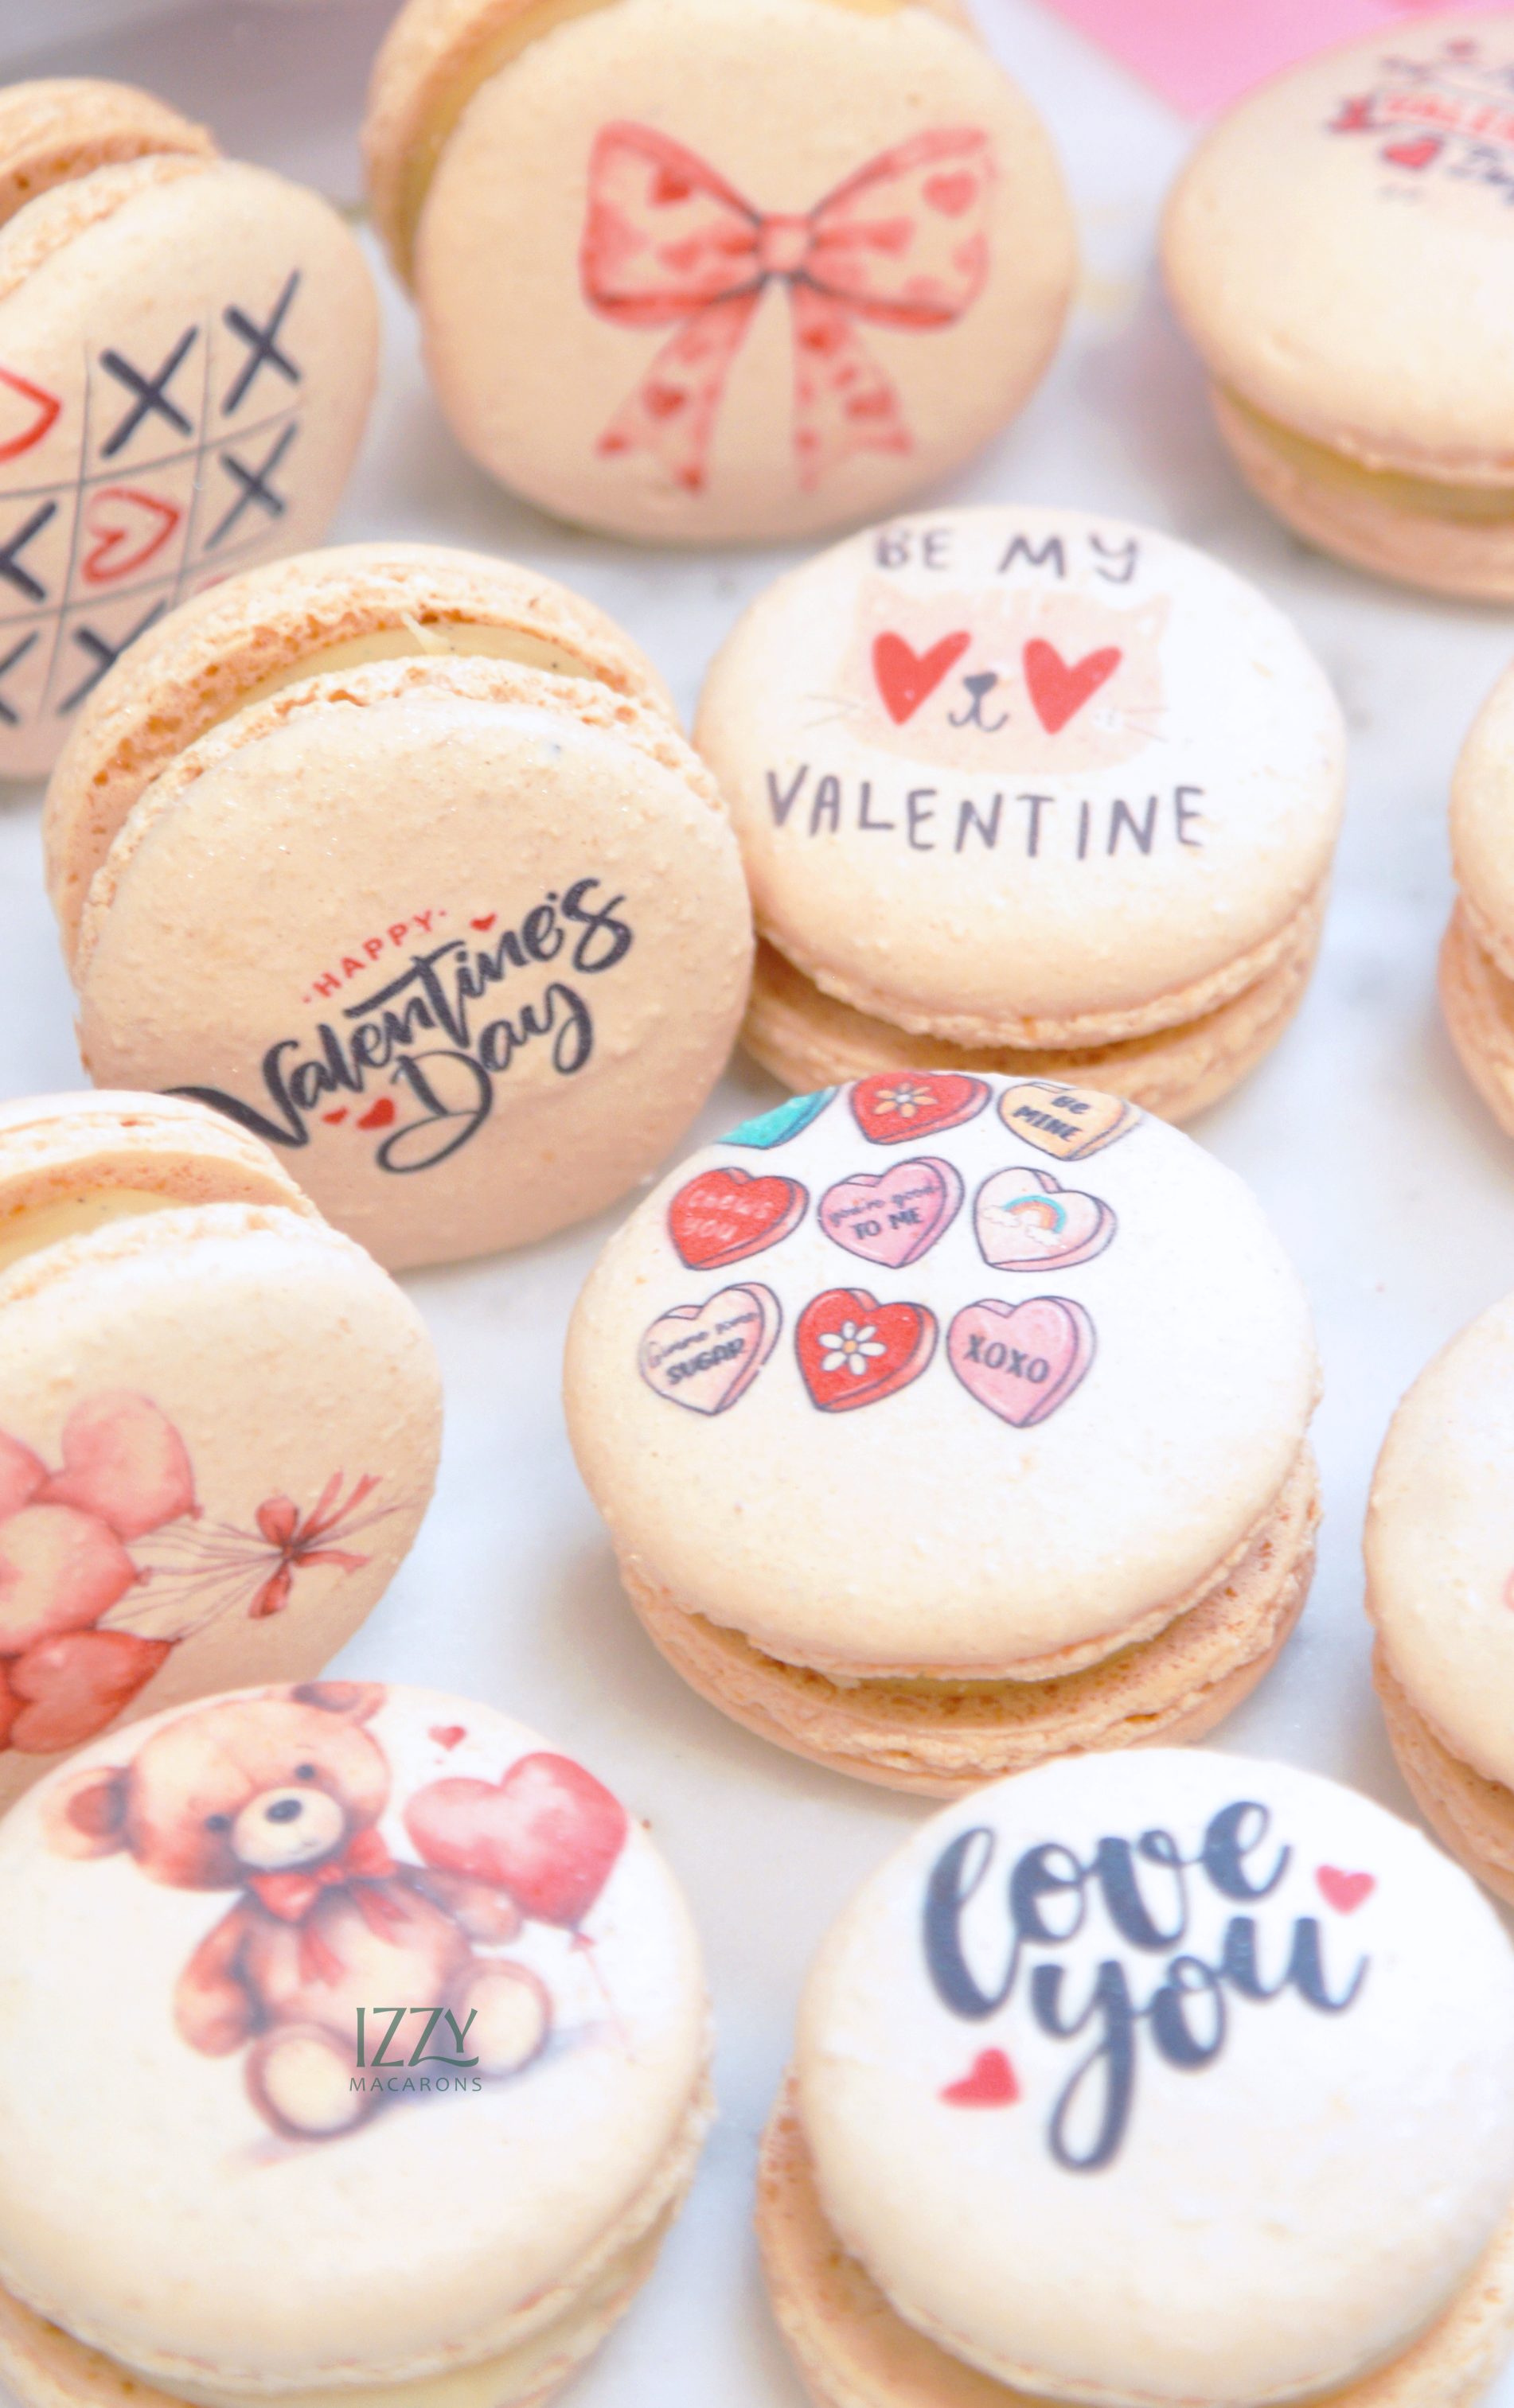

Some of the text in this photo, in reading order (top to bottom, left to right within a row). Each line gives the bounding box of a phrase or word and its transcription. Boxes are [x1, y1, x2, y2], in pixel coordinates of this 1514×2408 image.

[876, 528, 1137, 584] BE MY
[767, 763, 1205, 861] VALENTINE
[313, 910, 432, 997] HAPPY
[159, 877, 633, 1148] Valentine's
[375, 983, 593, 1175] Day
[1012, 1105, 1083, 1142] MINE
[849, 1207, 923, 1240] TO ME
[666, 1337, 747, 1385] SUGAR
[964, 1334, 1049, 1384] XOXO
[921, 1799, 1294, 2024] love
[1030, 1915, 1371, 2175] you
